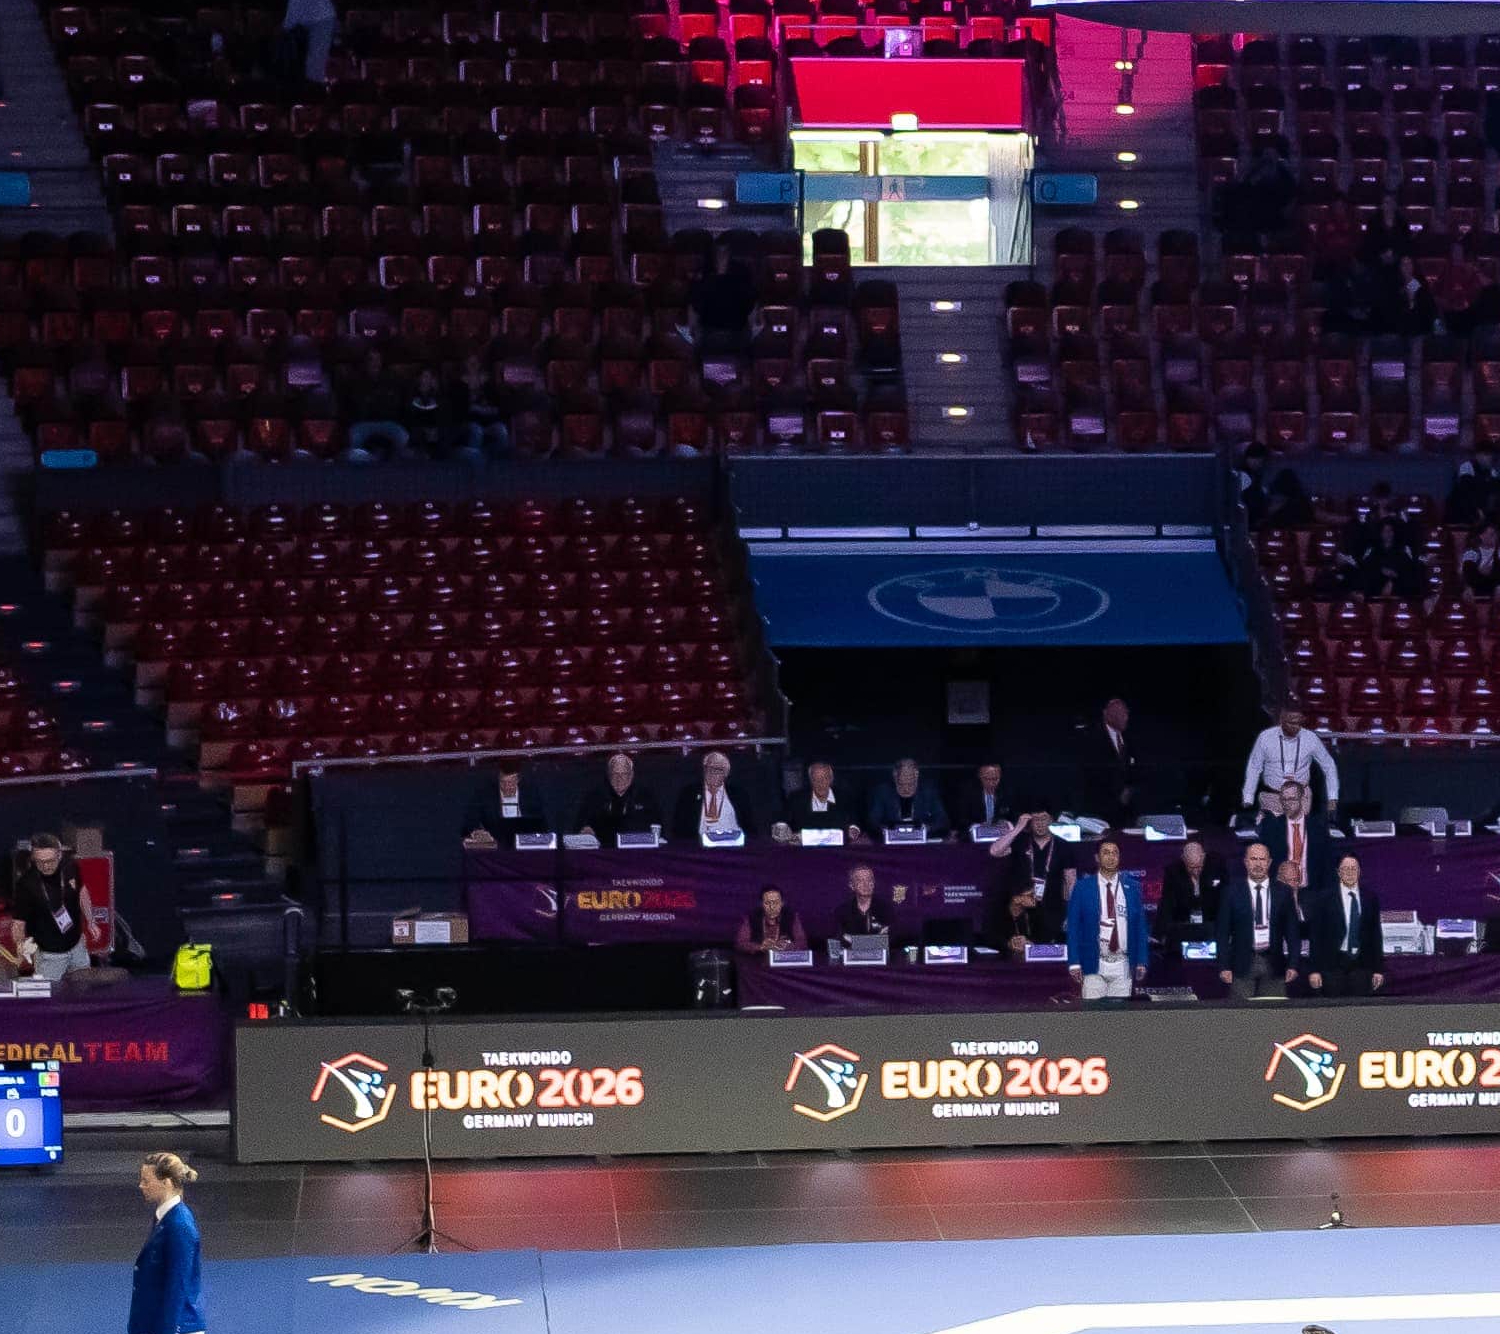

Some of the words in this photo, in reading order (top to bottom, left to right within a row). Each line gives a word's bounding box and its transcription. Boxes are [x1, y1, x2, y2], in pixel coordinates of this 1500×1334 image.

[780, 181, 793, 201] P
[577, 889, 642, 909] EURO
[84, 1041, 168, 1062] TEAM
[482, 1051, 571, 1066] TAEKWONDO
[951, 1041, 1038, 1056] TAEKWONDO
[881, 1059, 1002, 1099] EURO
[1004, 1056, 1110, 1099] 2026
[1359, 1050, 1476, 1089] EURO
[410, 1068, 534, 1112] EURO
[537, 1066, 644, 1108] 2026
[932, 1103, 1001, 1118] GERMANY
[1004, 1102, 1059, 1116] MUNICH
[1408, 1093, 1475, 1107] GERMANY
[5, 1108, 26, 1137] 0
[463, 1114, 533, 1129] GERMANY
[537, 1113, 593, 1127] MUNICH
